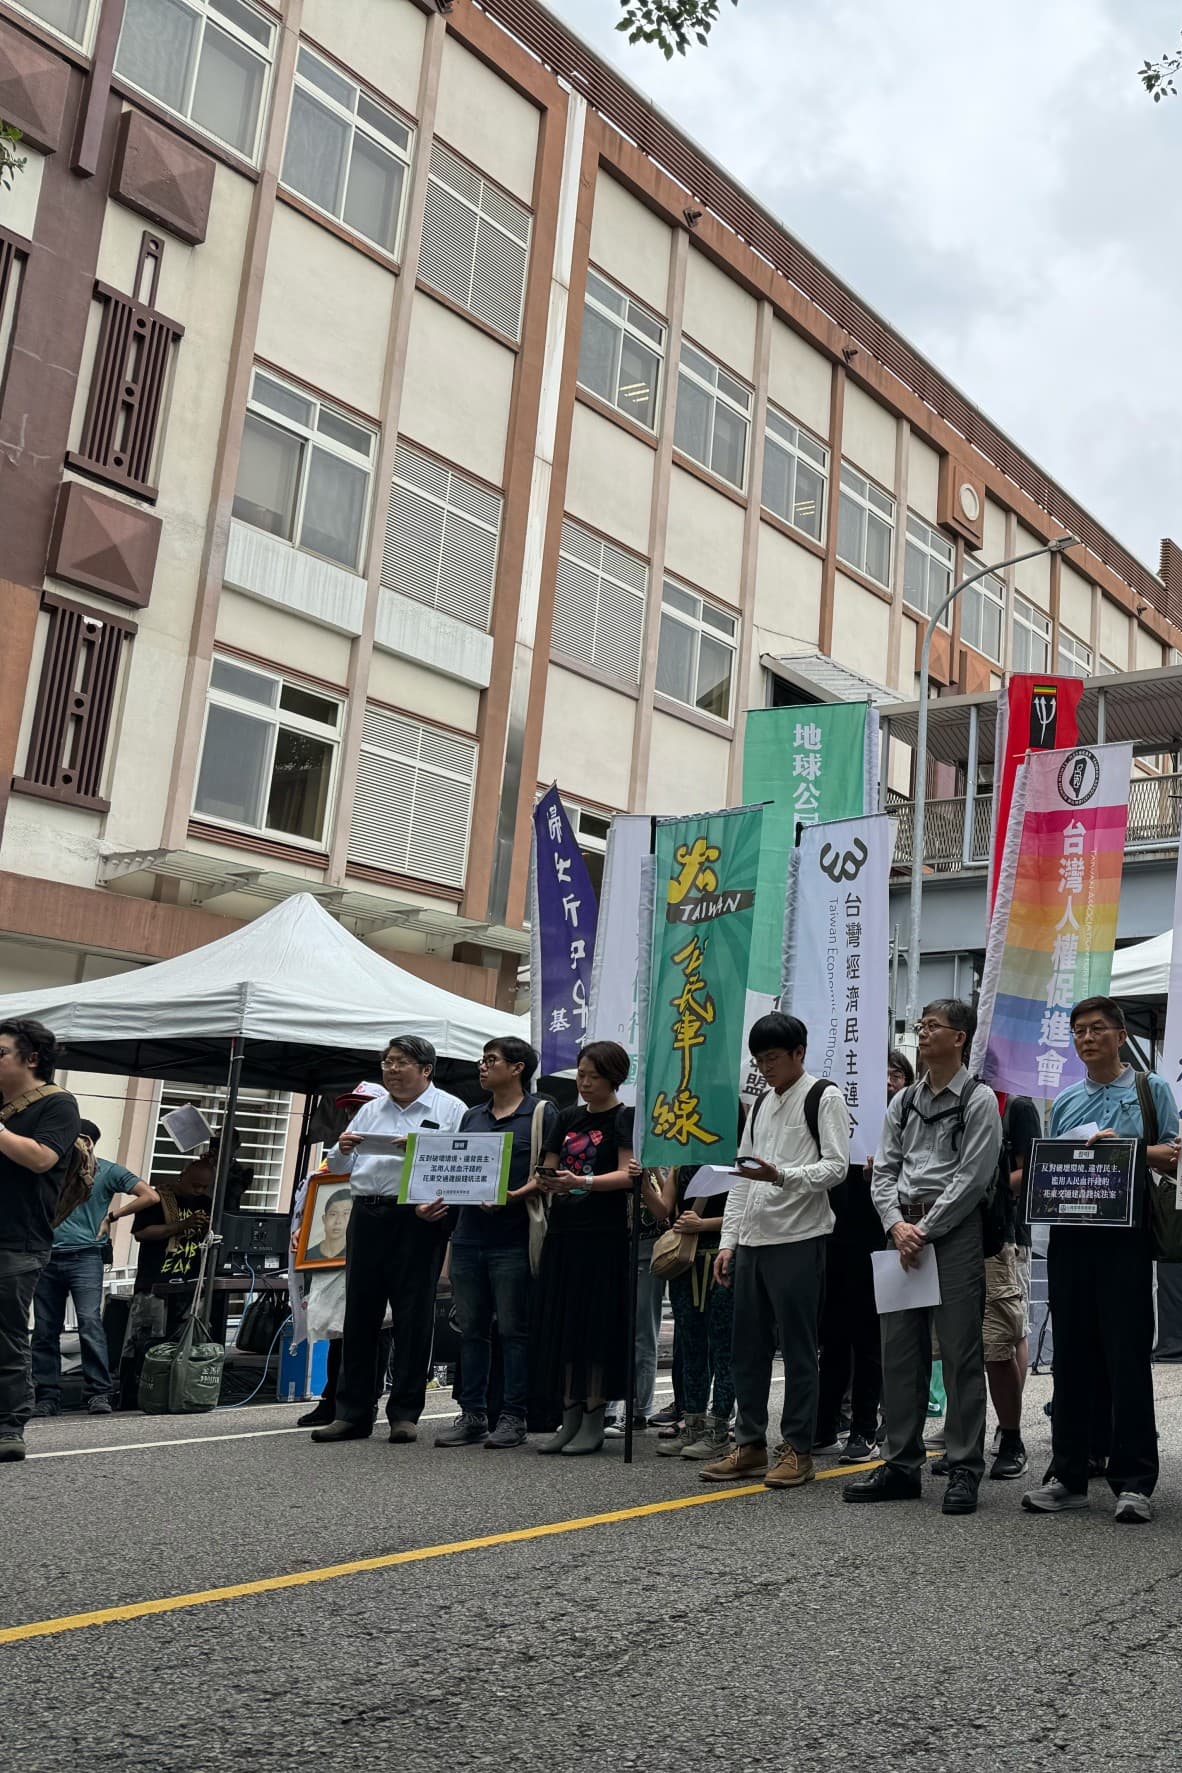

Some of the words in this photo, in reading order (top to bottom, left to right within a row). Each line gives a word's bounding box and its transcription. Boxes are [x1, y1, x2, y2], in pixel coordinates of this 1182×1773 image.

[680, 893, 742, 921] TAIWAN
[828, 896, 839, 944] Taiwan
[826, 948, 838, 1015] Econo
[1035, 818, 1088, 1088] 台灣人權促進會
